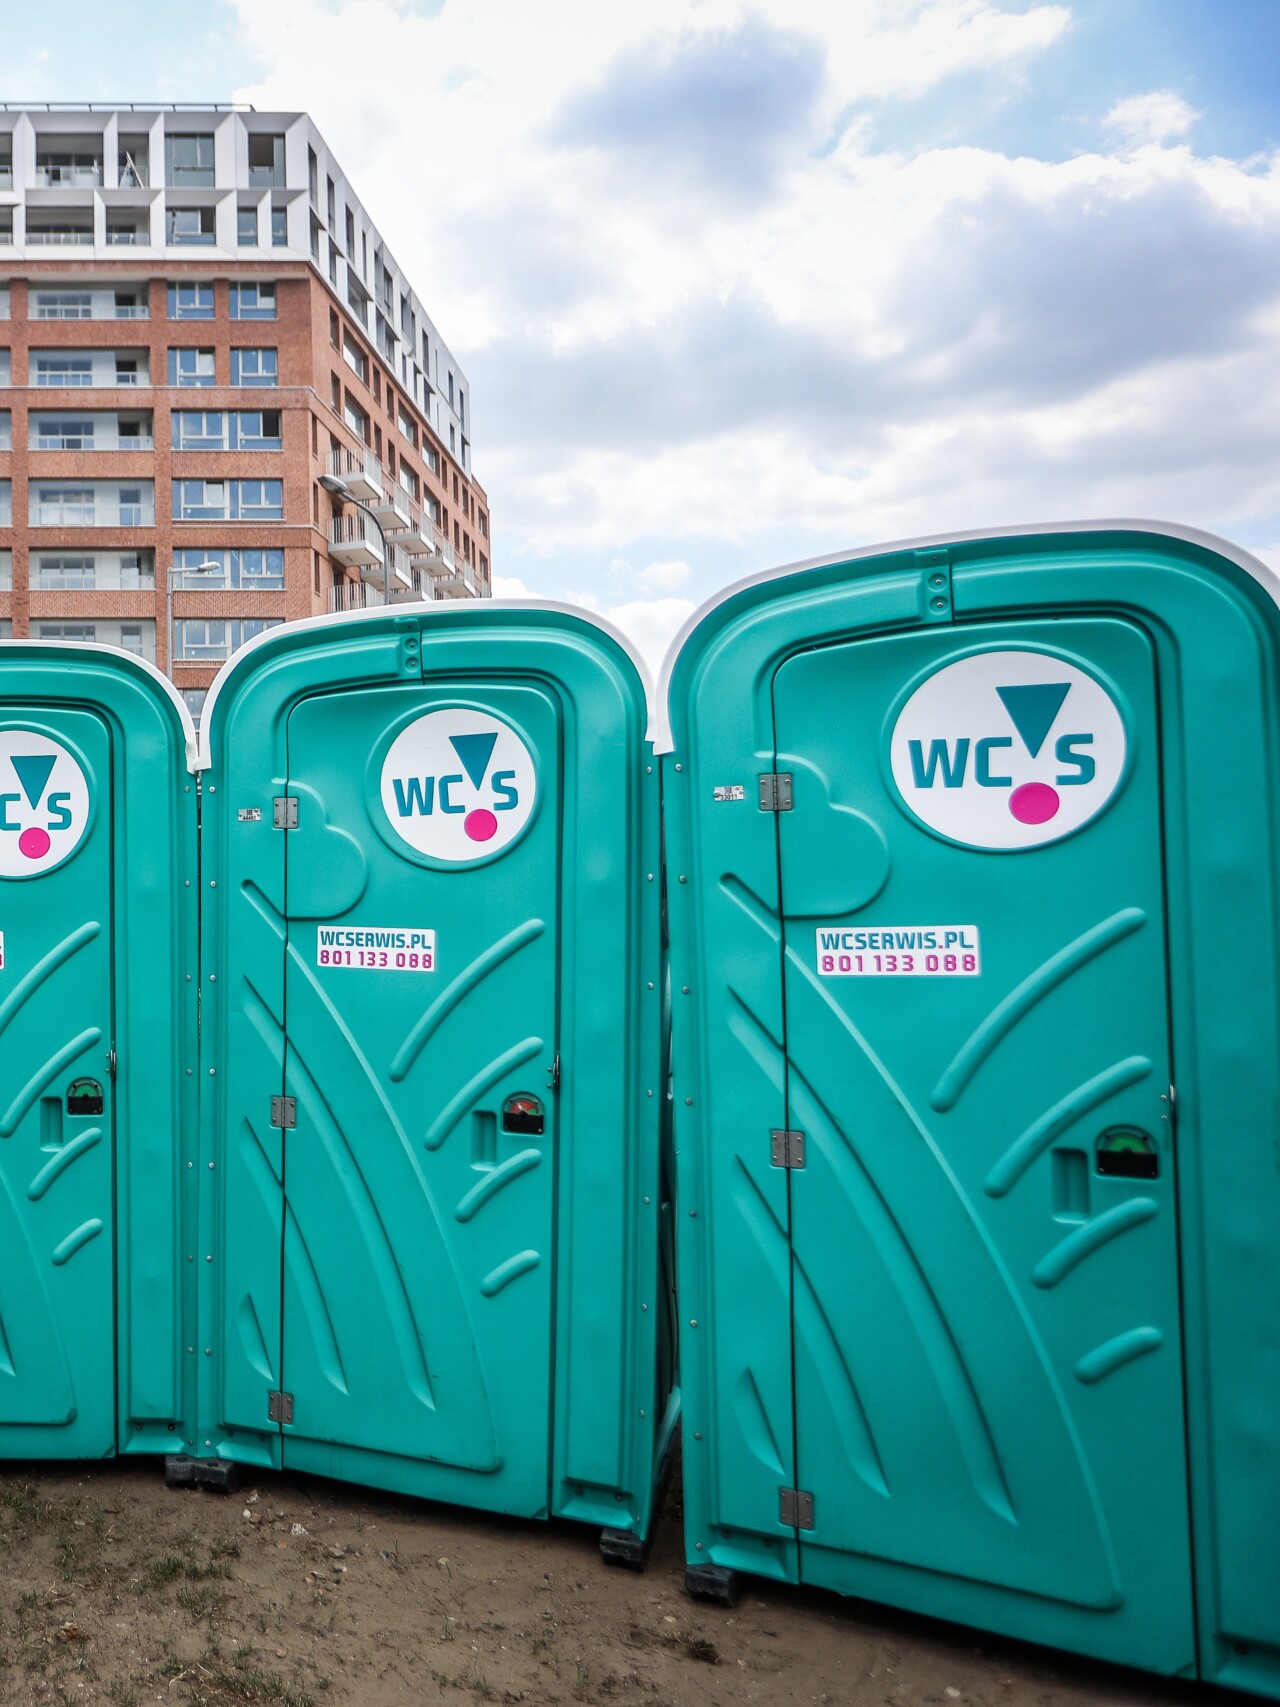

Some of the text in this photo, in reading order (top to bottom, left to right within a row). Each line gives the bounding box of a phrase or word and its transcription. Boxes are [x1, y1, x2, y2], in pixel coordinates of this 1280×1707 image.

[319, 930, 433, 950] WCSERWIS.PL
[820, 931, 975, 950] WCSERWIS.PL
[320, 950, 433, 968] 801 133 088
[821, 954, 977, 972] 801 133 088
